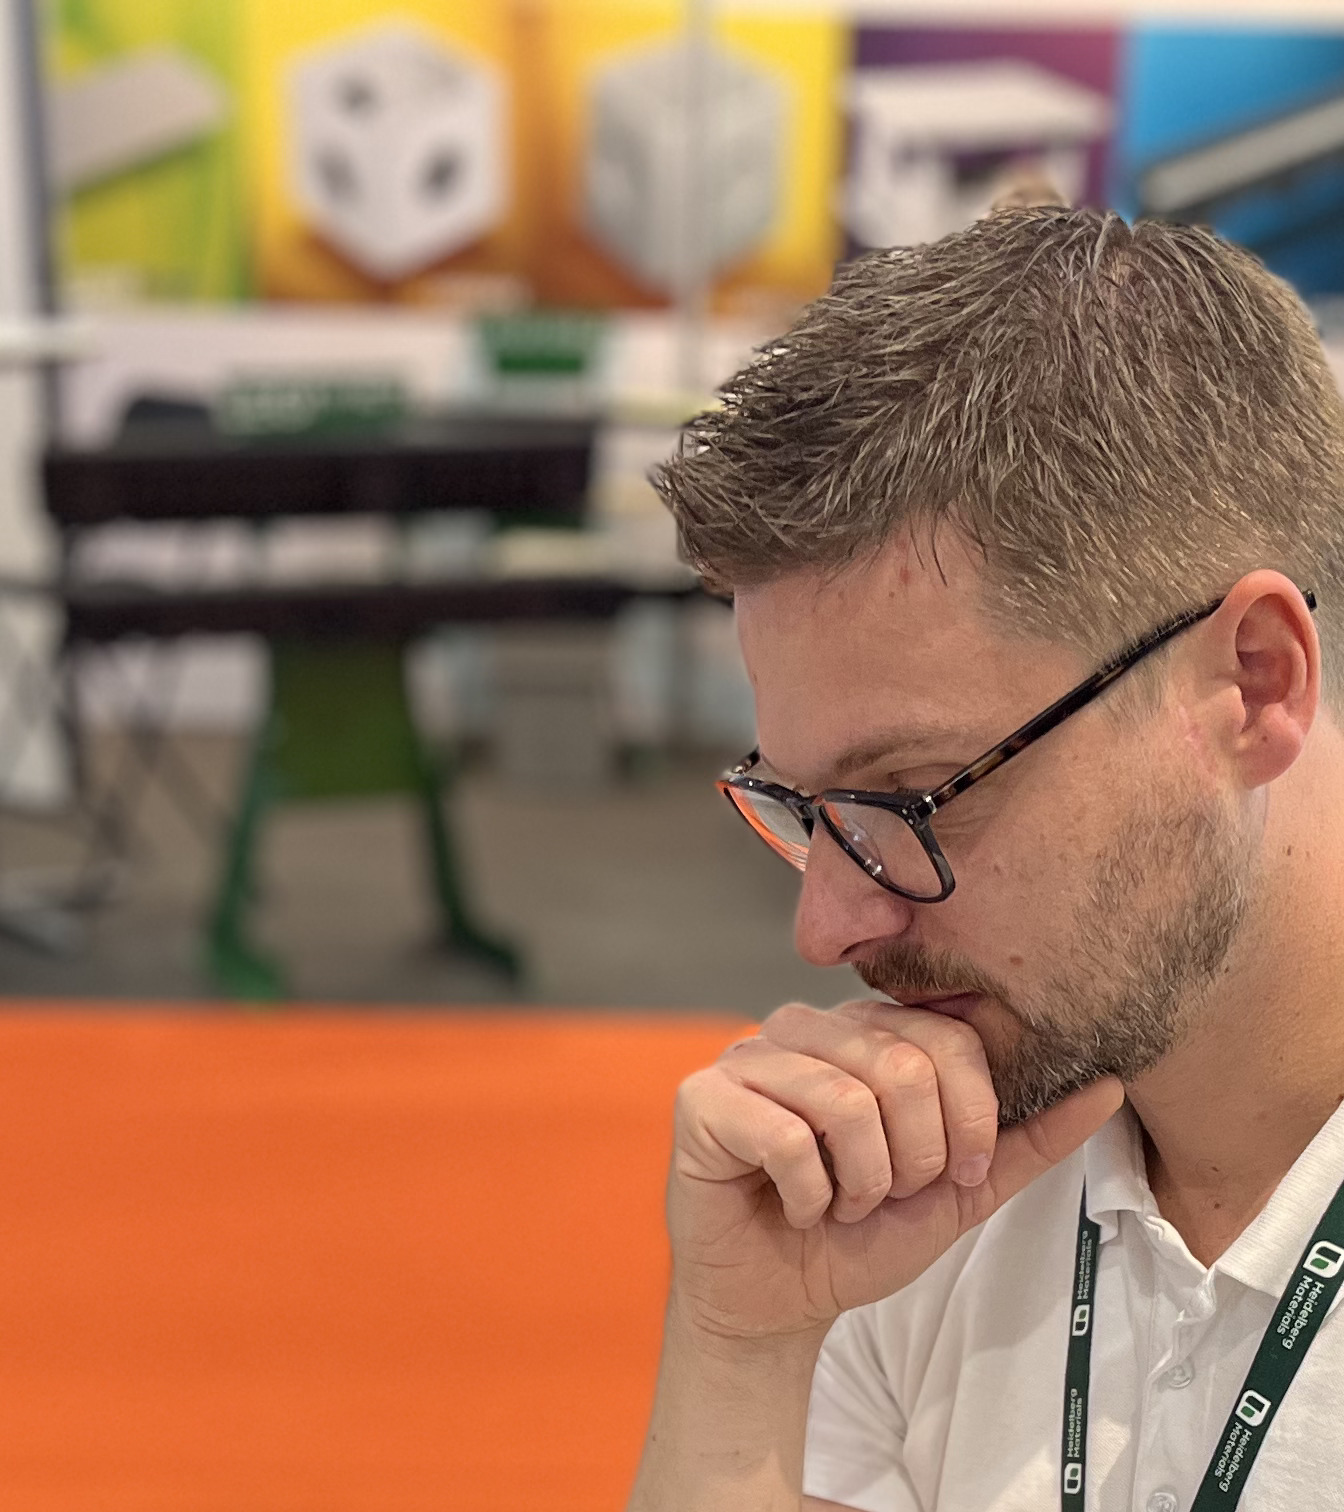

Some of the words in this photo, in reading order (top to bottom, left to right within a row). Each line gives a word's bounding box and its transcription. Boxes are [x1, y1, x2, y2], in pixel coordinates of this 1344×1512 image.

[1277, 1275, 1313, 1334] Materials
[1282, 1281, 1324, 1350] Heidelberg
[1067, 1388, 1078, 1458] Heidelberg
[1074, 1398, 1082, 1458] Materials
[1214, 1422, 1243, 1478] Materials
[1218, 1428, 1252, 1492] Heidelberg
